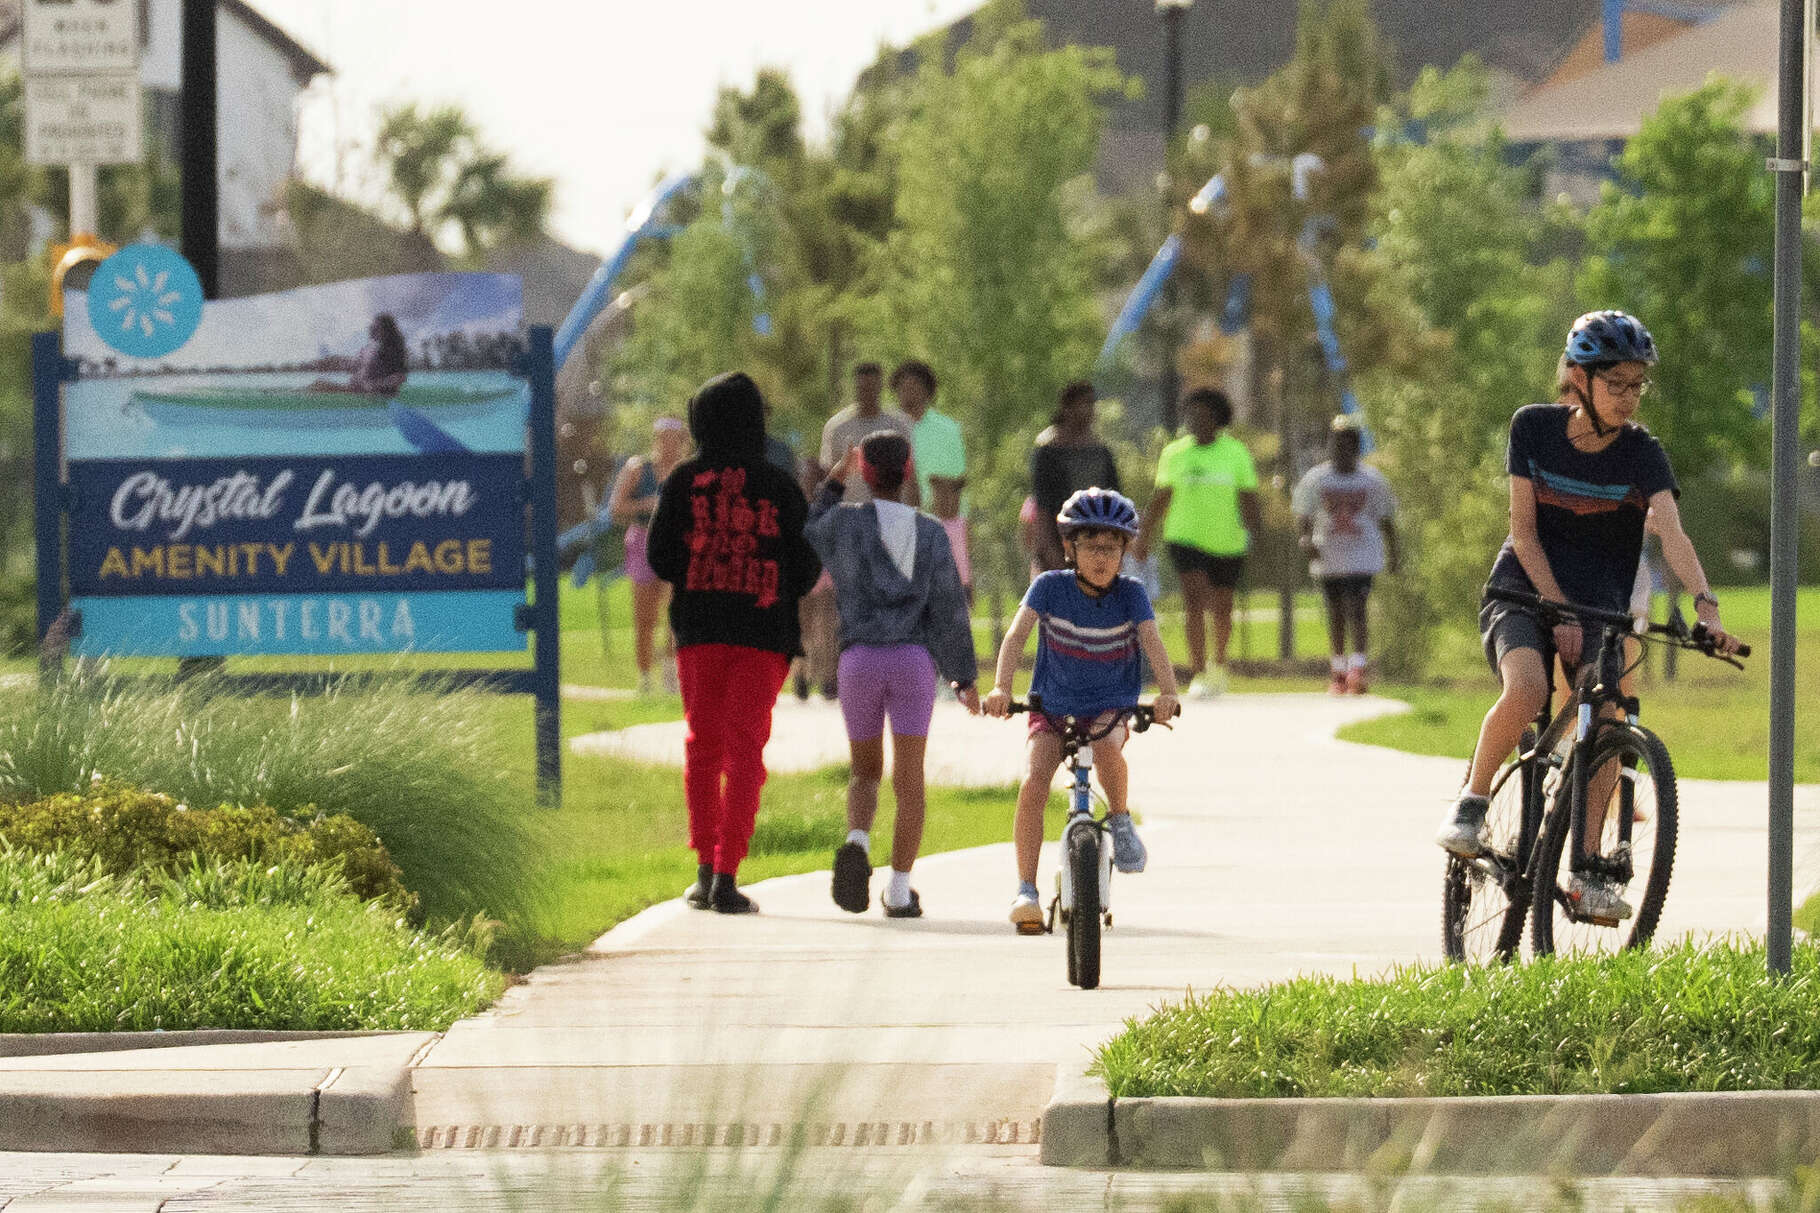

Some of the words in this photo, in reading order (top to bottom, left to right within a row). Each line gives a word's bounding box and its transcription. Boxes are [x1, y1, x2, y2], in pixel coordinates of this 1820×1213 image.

[110, 470, 292, 541] Crystal
[293, 469, 474, 537] Lagoon
[100, 542, 294, 579] AMENITY
[308, 539, 492, 576] VILLAGE
[178, 600, 415, 643] SUNTERRA
